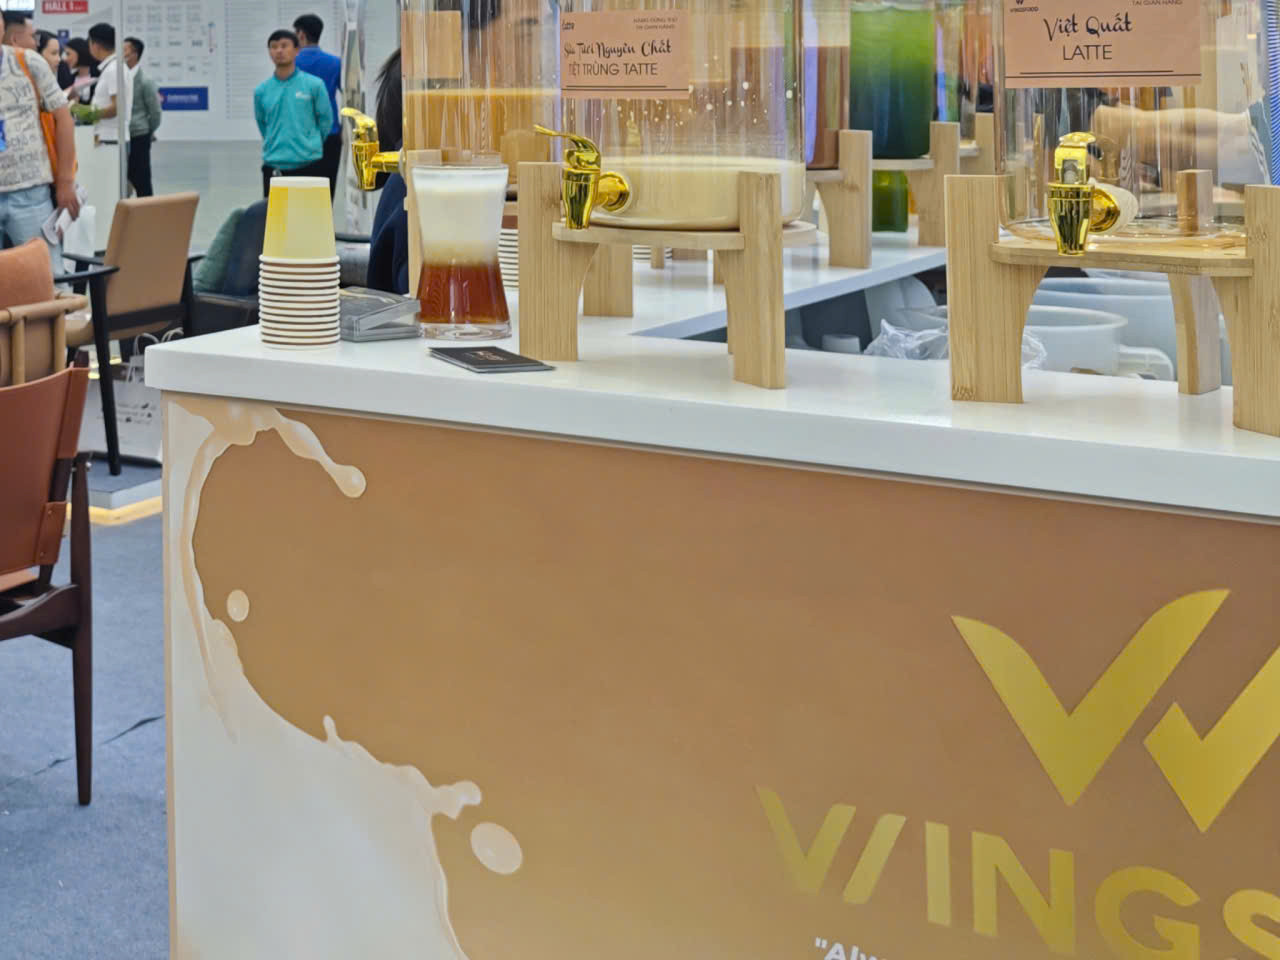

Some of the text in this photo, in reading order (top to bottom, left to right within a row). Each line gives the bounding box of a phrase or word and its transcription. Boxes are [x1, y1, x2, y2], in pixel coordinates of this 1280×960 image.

[1043, 11, 1133, 42] Việt Quất
[641, 38, 673, 57] Chất
[1063, 44, 1113, 61] LATTE
[583, 60, 620, 76] TRÙNG
[623, 62, 659, 76] TATTE
